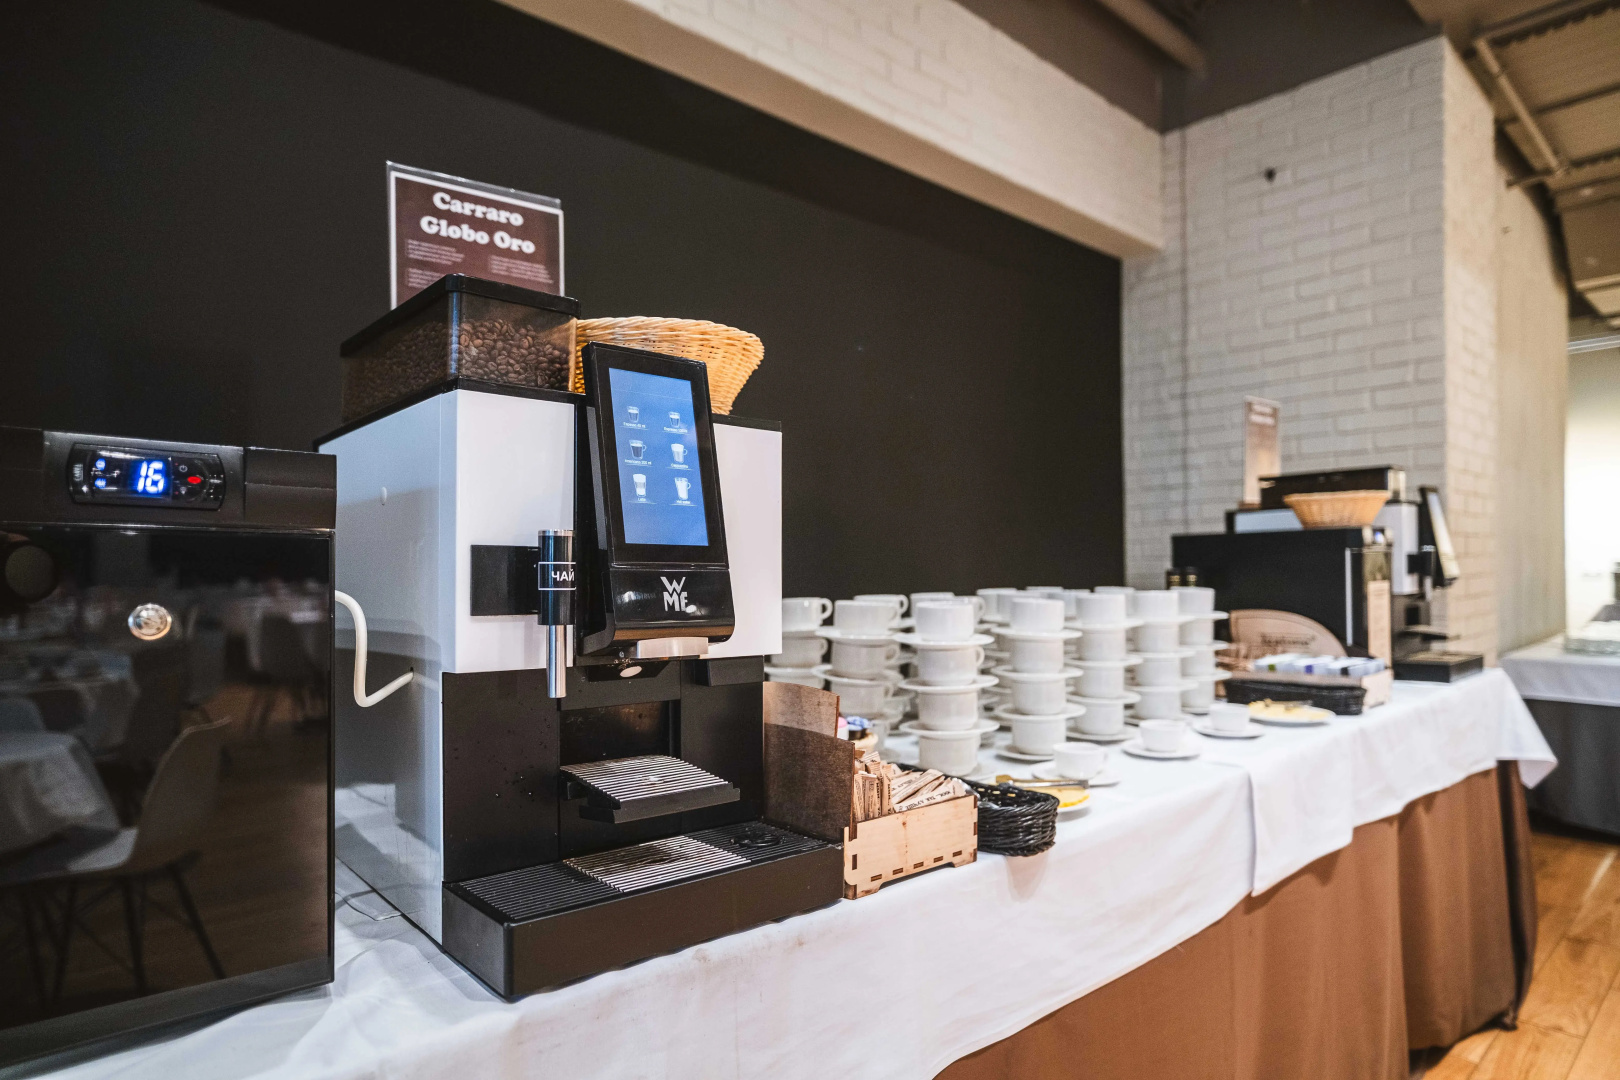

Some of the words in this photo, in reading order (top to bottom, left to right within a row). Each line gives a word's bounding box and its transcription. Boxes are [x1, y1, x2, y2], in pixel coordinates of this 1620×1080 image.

[432, 191, 524, 227] Carraro
[419, 215, 490, 245] Globo
[493, 230, 536, 254] Oro
[137, 460, 165, 494] 16
[551, 569, 575, 581] ЧАЙ
